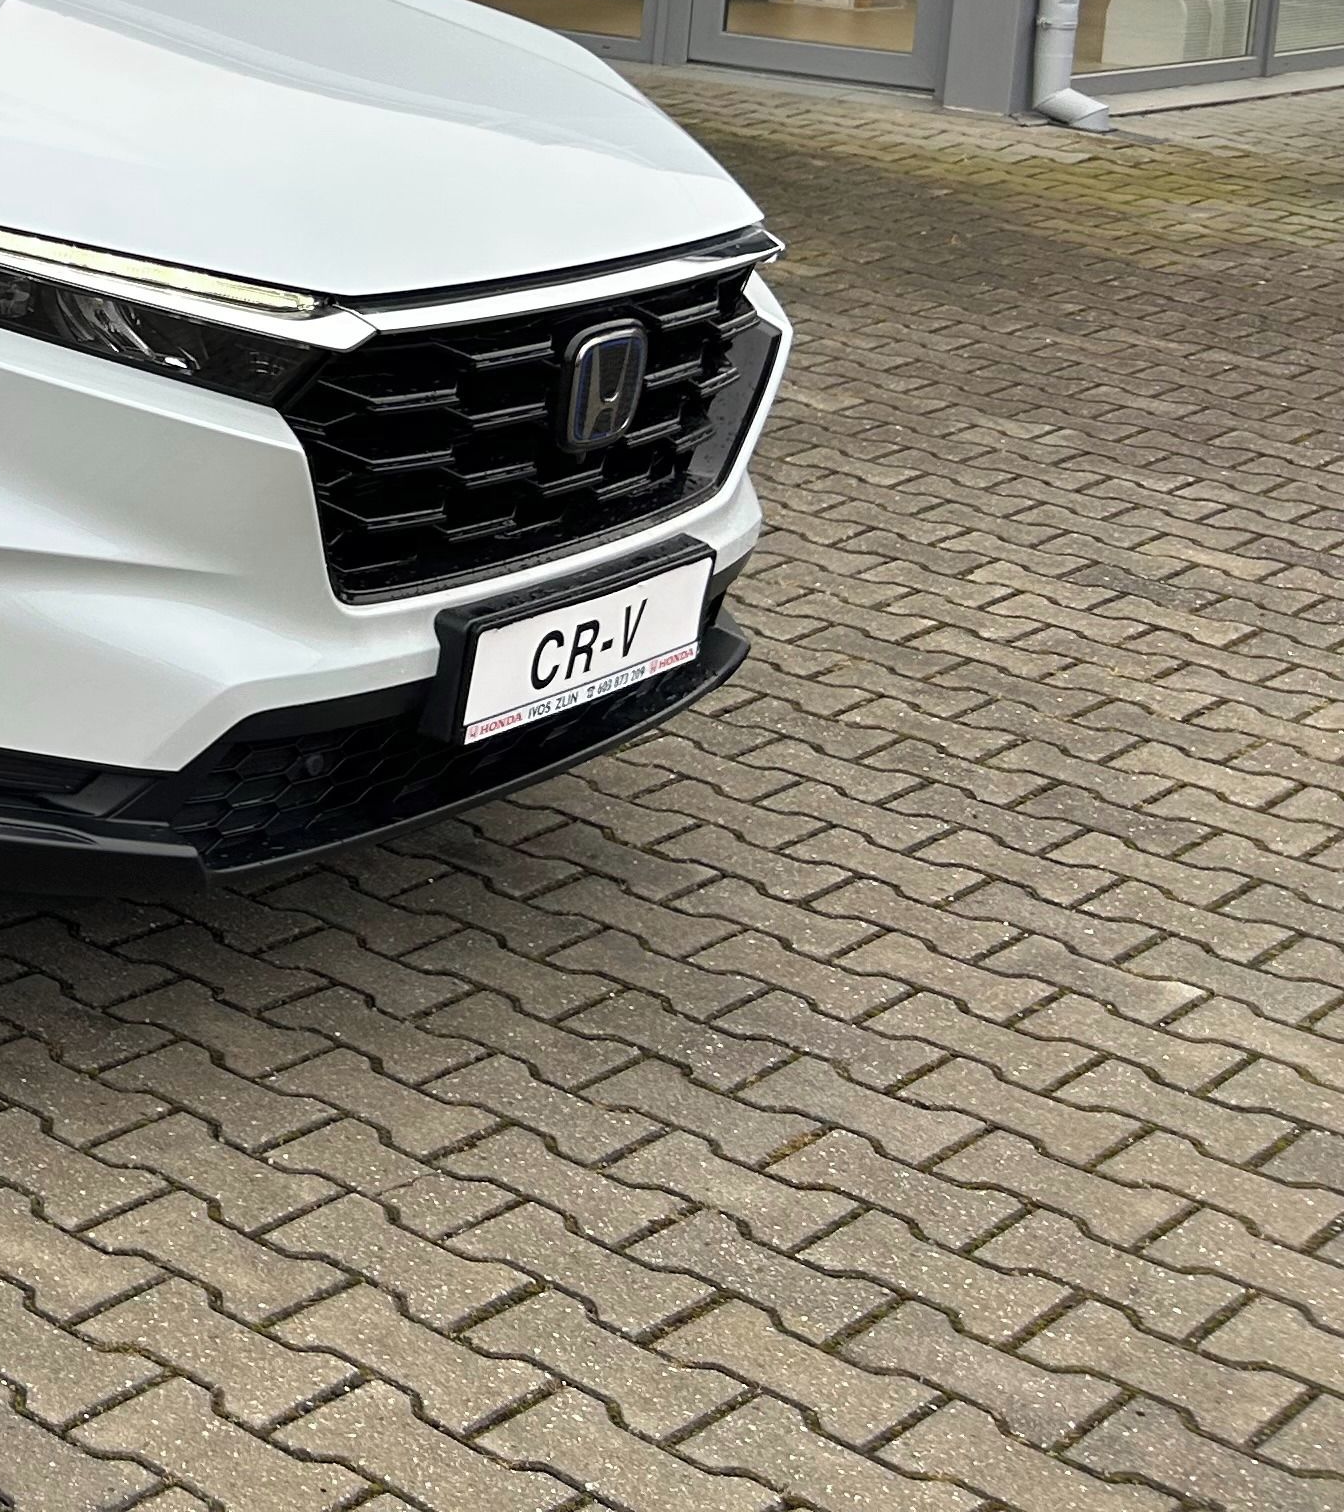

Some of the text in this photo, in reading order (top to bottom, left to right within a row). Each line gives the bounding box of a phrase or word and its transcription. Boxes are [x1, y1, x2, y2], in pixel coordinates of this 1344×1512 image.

[530, 598, 648, 690] CR-V
[479, 712, 523, 735] HONDA
[659, 648, 694, 668] HONDA
